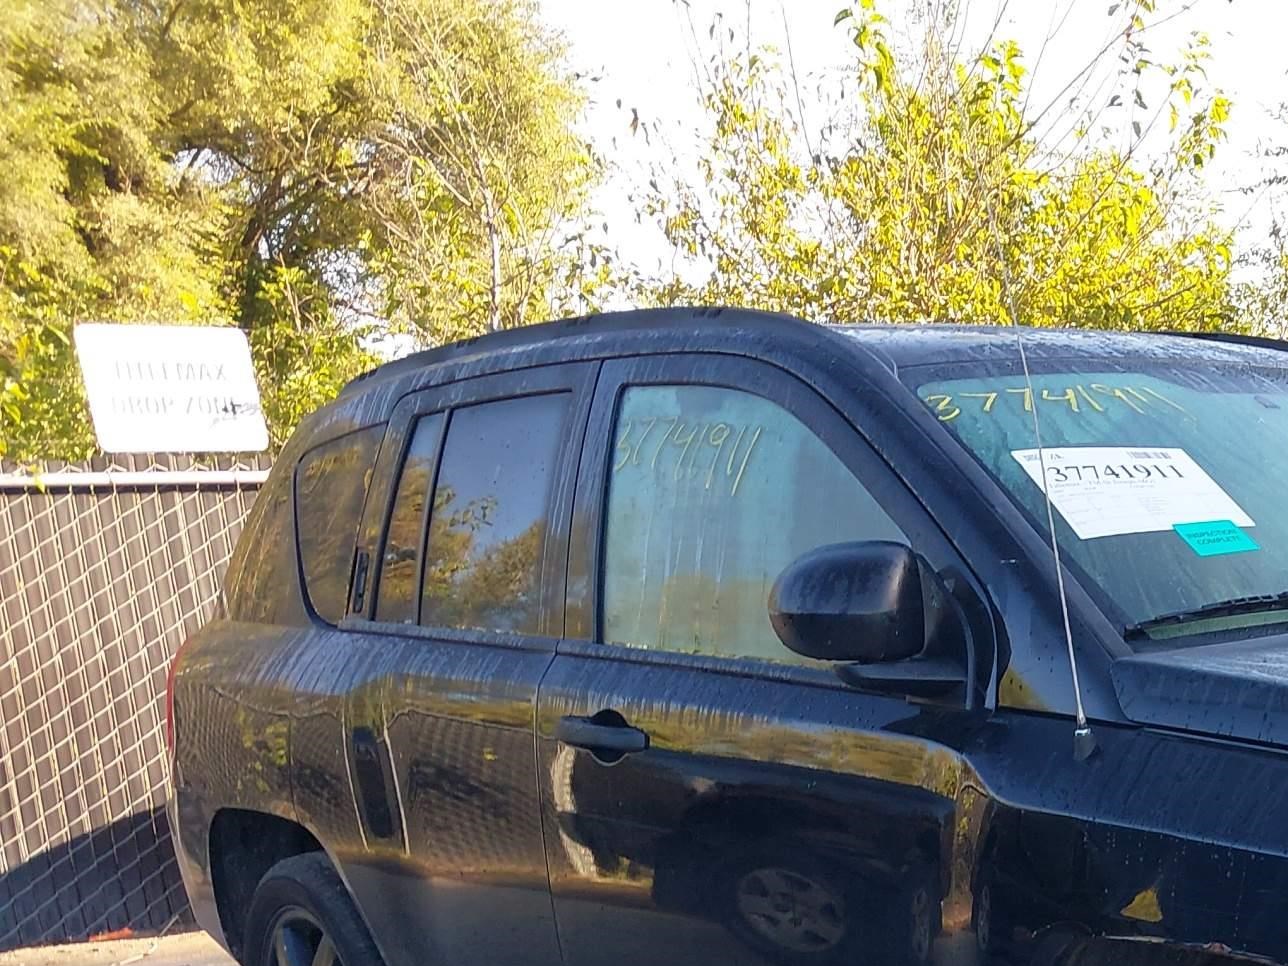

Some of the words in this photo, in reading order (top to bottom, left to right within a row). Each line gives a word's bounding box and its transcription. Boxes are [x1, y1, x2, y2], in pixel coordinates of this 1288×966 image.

[927, 384, 1198, 421] 37741911
[614, 416, 761, 497] 37741911
[1047, 464, 1184, 482] 37741911
